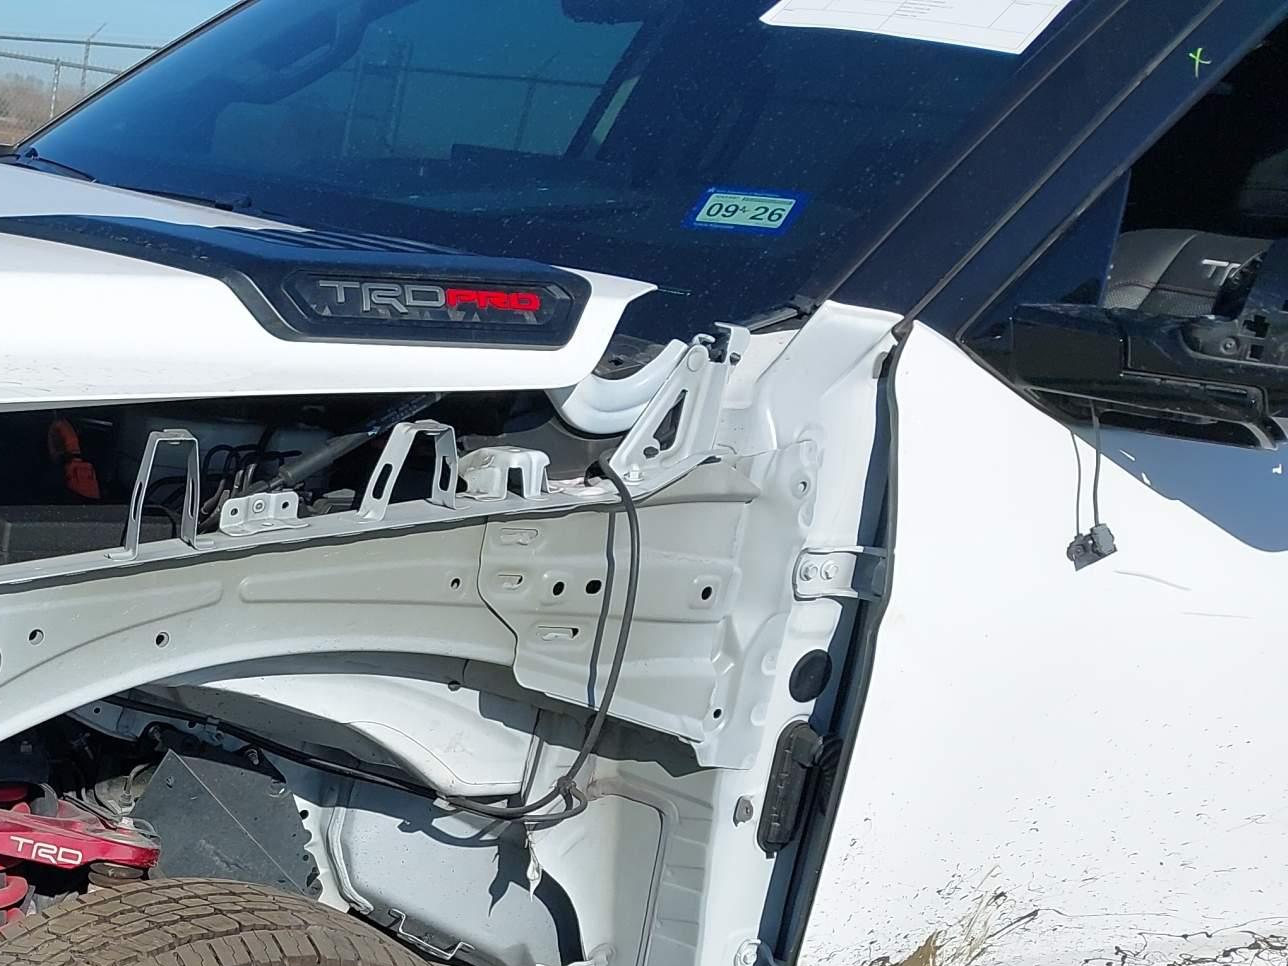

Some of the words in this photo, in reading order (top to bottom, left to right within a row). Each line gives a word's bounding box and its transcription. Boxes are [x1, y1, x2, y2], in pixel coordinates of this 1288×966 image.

[706, 202, 739, 218] 09
[749, 206, 786, 222] 26
[10, 835, 83, 865] TRD
